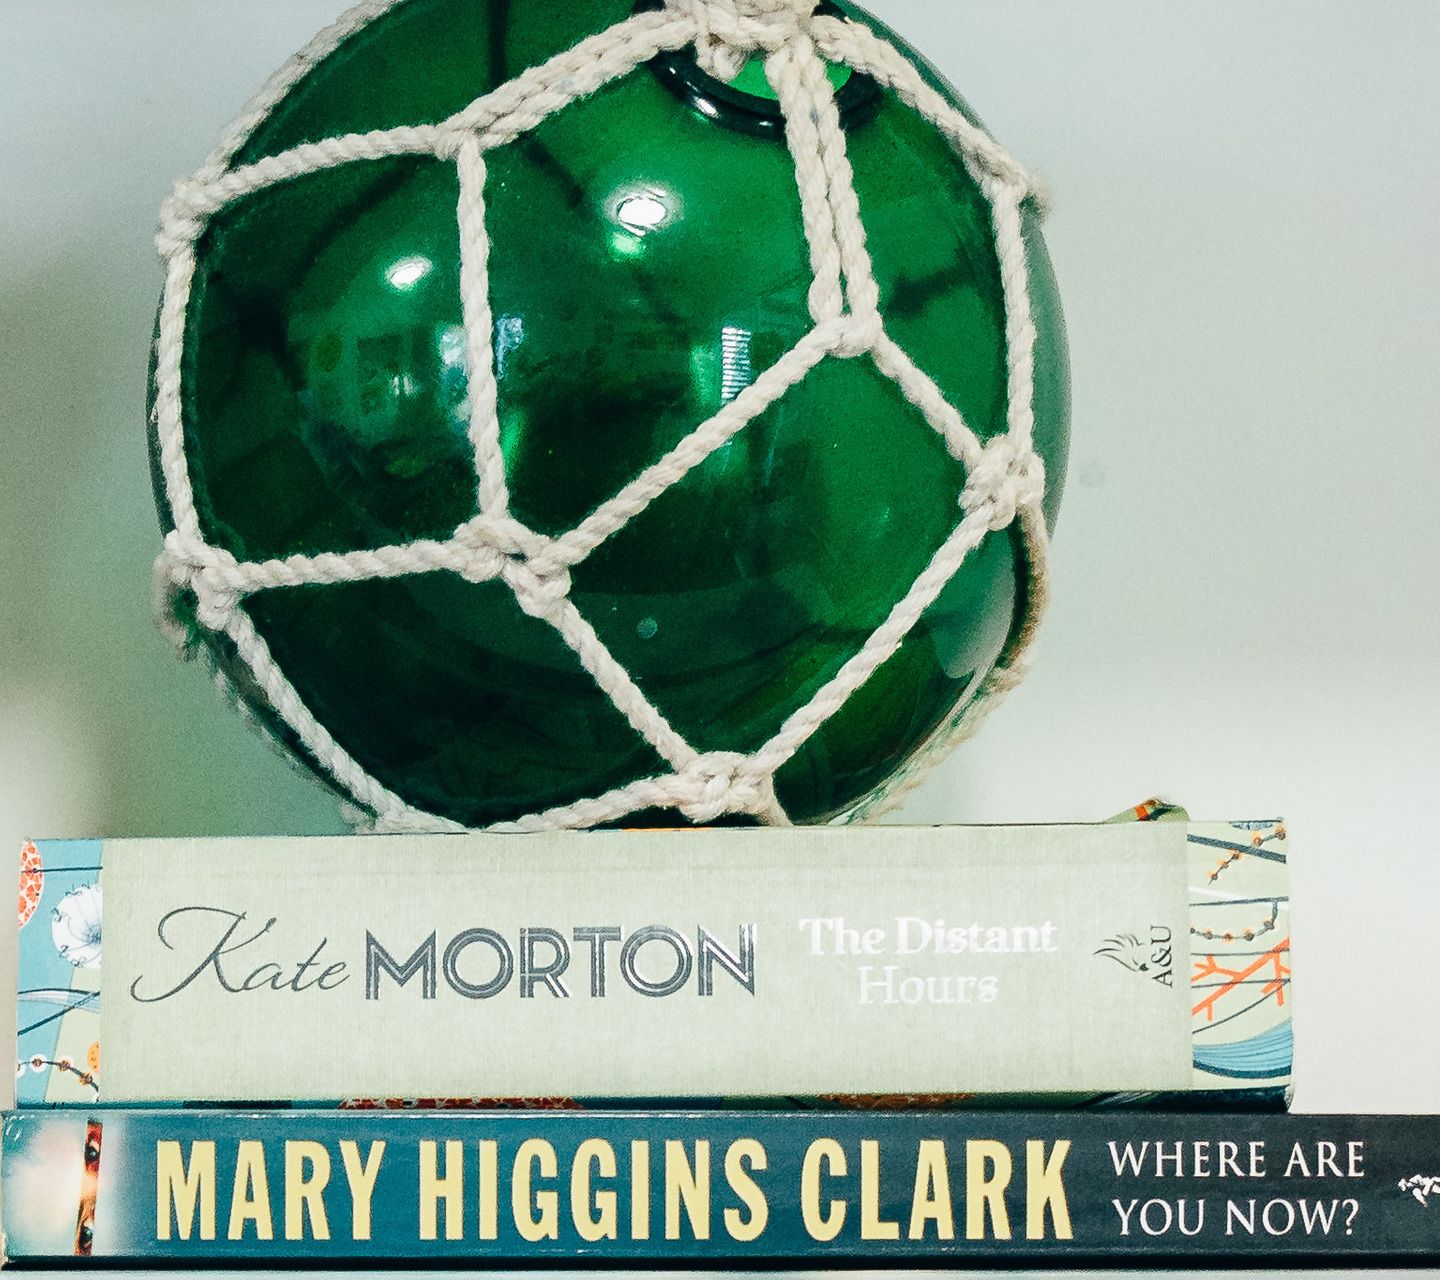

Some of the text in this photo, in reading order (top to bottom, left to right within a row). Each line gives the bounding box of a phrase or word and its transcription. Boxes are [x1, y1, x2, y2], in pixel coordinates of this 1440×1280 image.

[130, 906, 758, 1003] Kate MORTON
[798, 917, 1057, 956] The Distant
[1151, 924, 1174, 987] A&U
[857, 965, 999, 1006] Hours
[1106, 1140, 1366, 1178] WHERE ARE
[155, 1138, 1075, 1242] MARY HIGGINS CLARK
[1113, 1198, 1360, 1237] YOU NOW?
